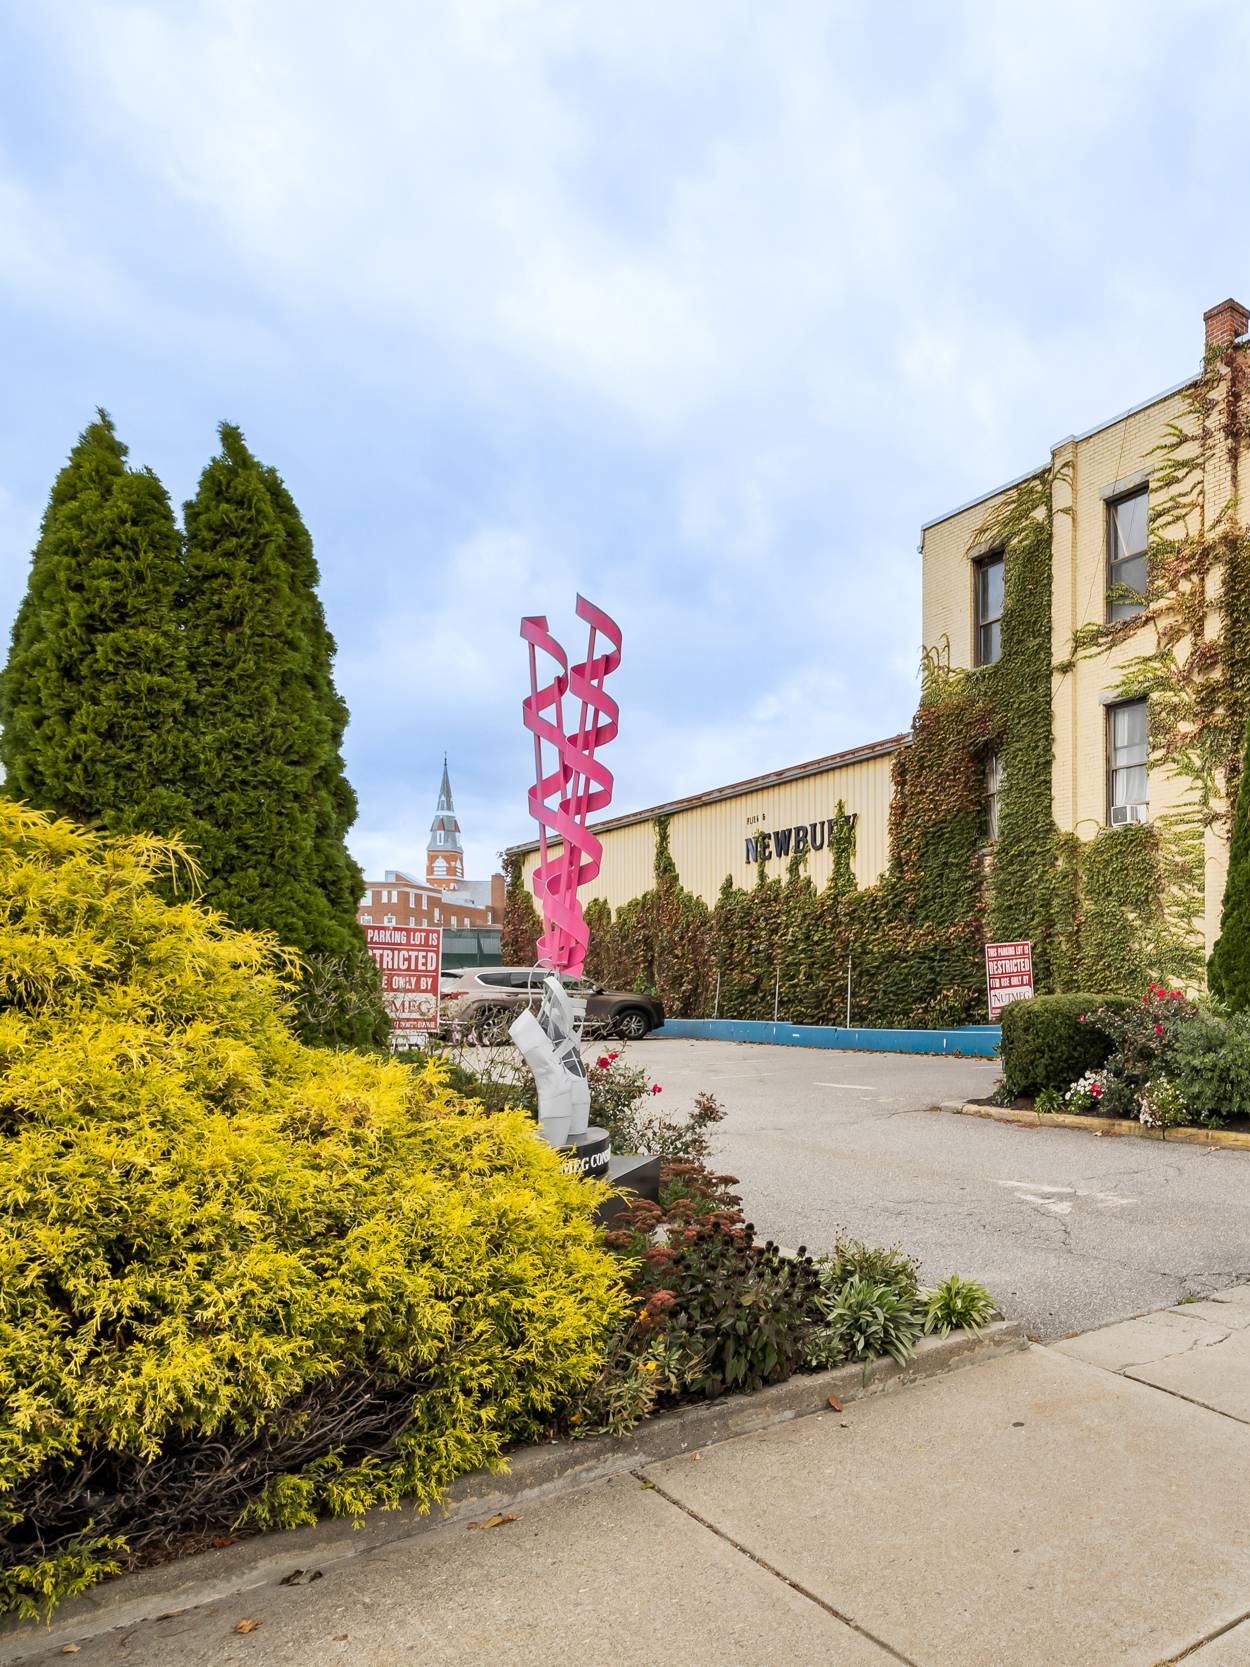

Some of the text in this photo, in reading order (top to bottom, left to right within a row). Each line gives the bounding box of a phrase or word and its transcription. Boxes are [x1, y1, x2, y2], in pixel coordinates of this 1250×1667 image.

[367, 929, 438, 946] PARKING LOT IS
[368, 948, 437, 971] TRICTED
[988, 959, 1030, 974] RESTRICTED
[392, 975, 416, 989] ONLY
[420, 977, 433, 990] BY
